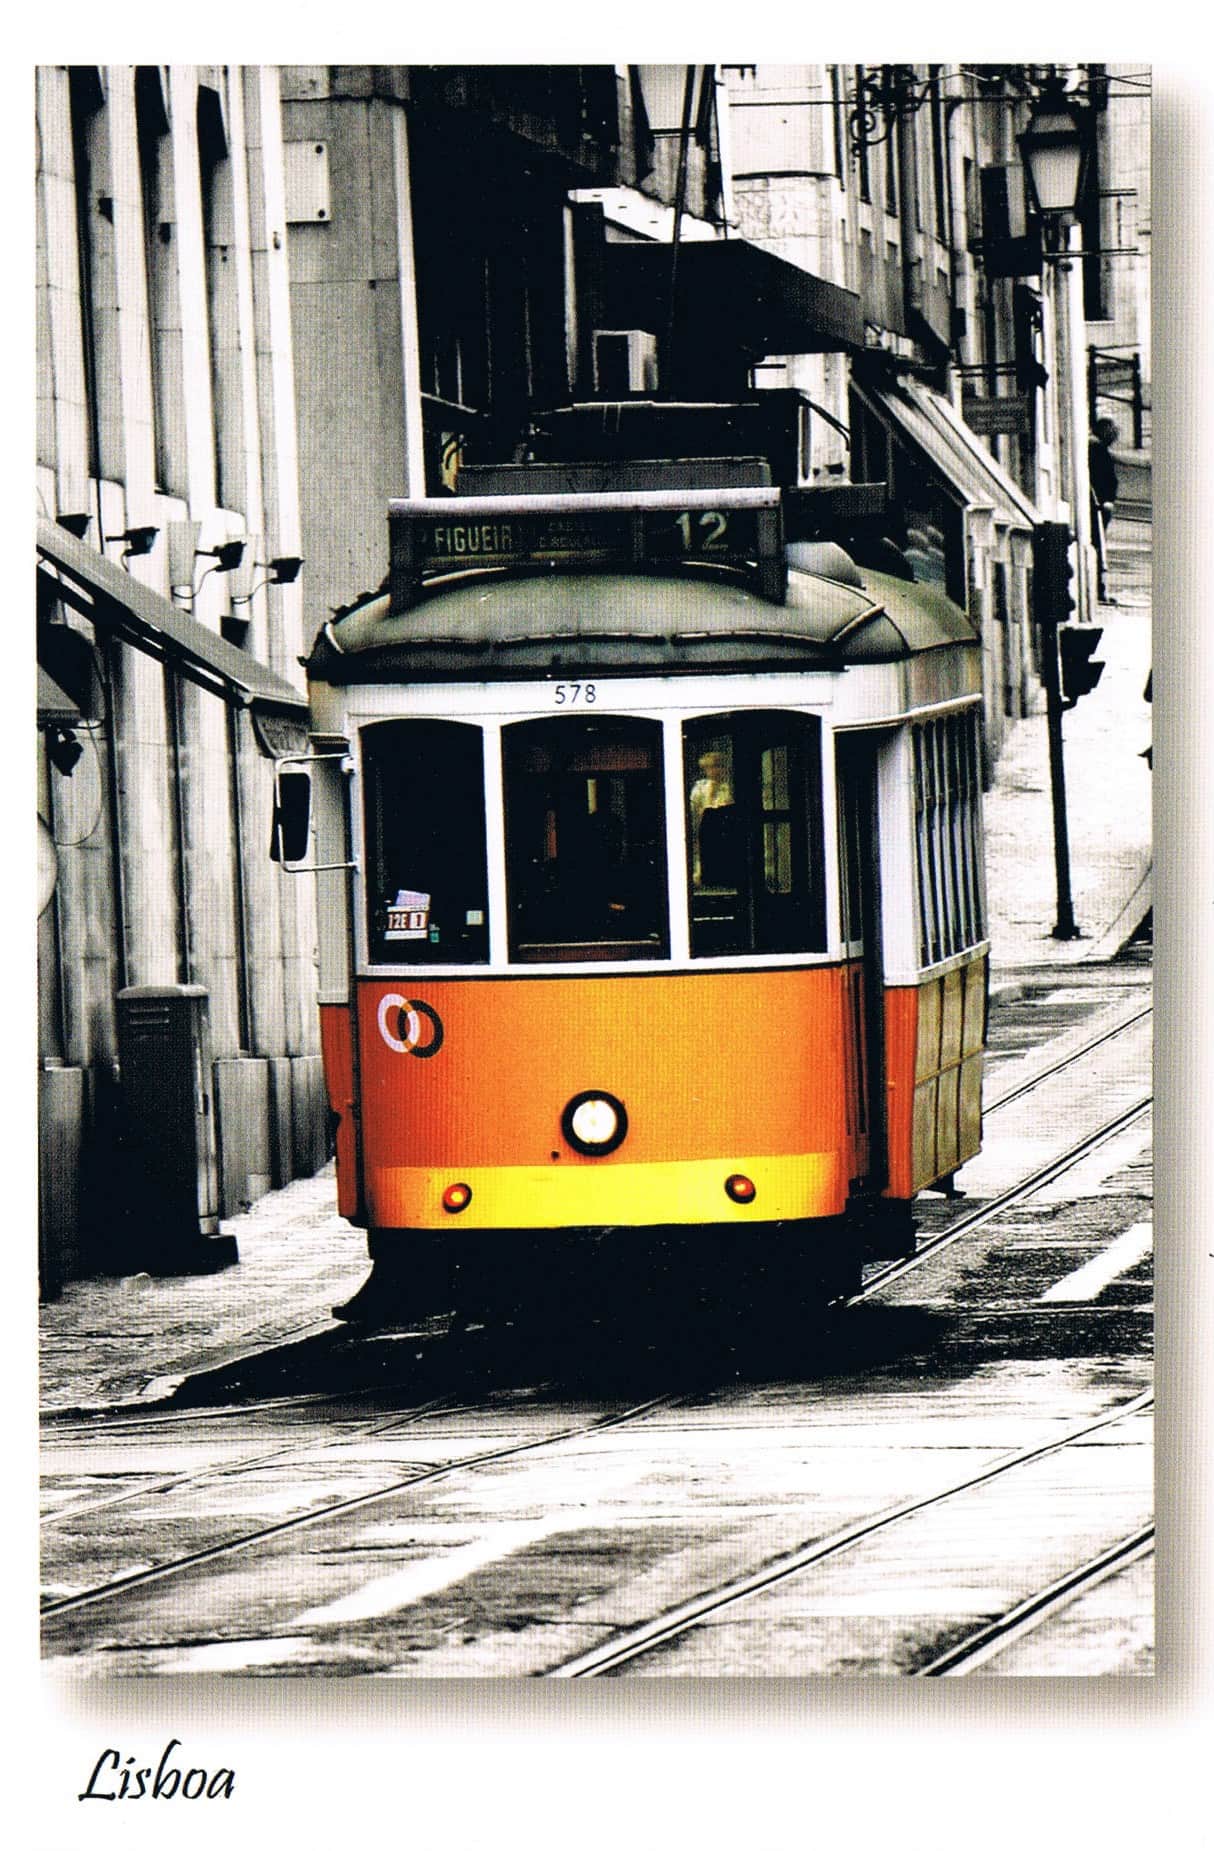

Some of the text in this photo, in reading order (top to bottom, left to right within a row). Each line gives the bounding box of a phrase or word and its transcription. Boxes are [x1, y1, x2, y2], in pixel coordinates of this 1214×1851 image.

[675, 511, 729, 550] 12
[555, 684, 596, 704] 578
[388, 912, 408, 929] 12E
